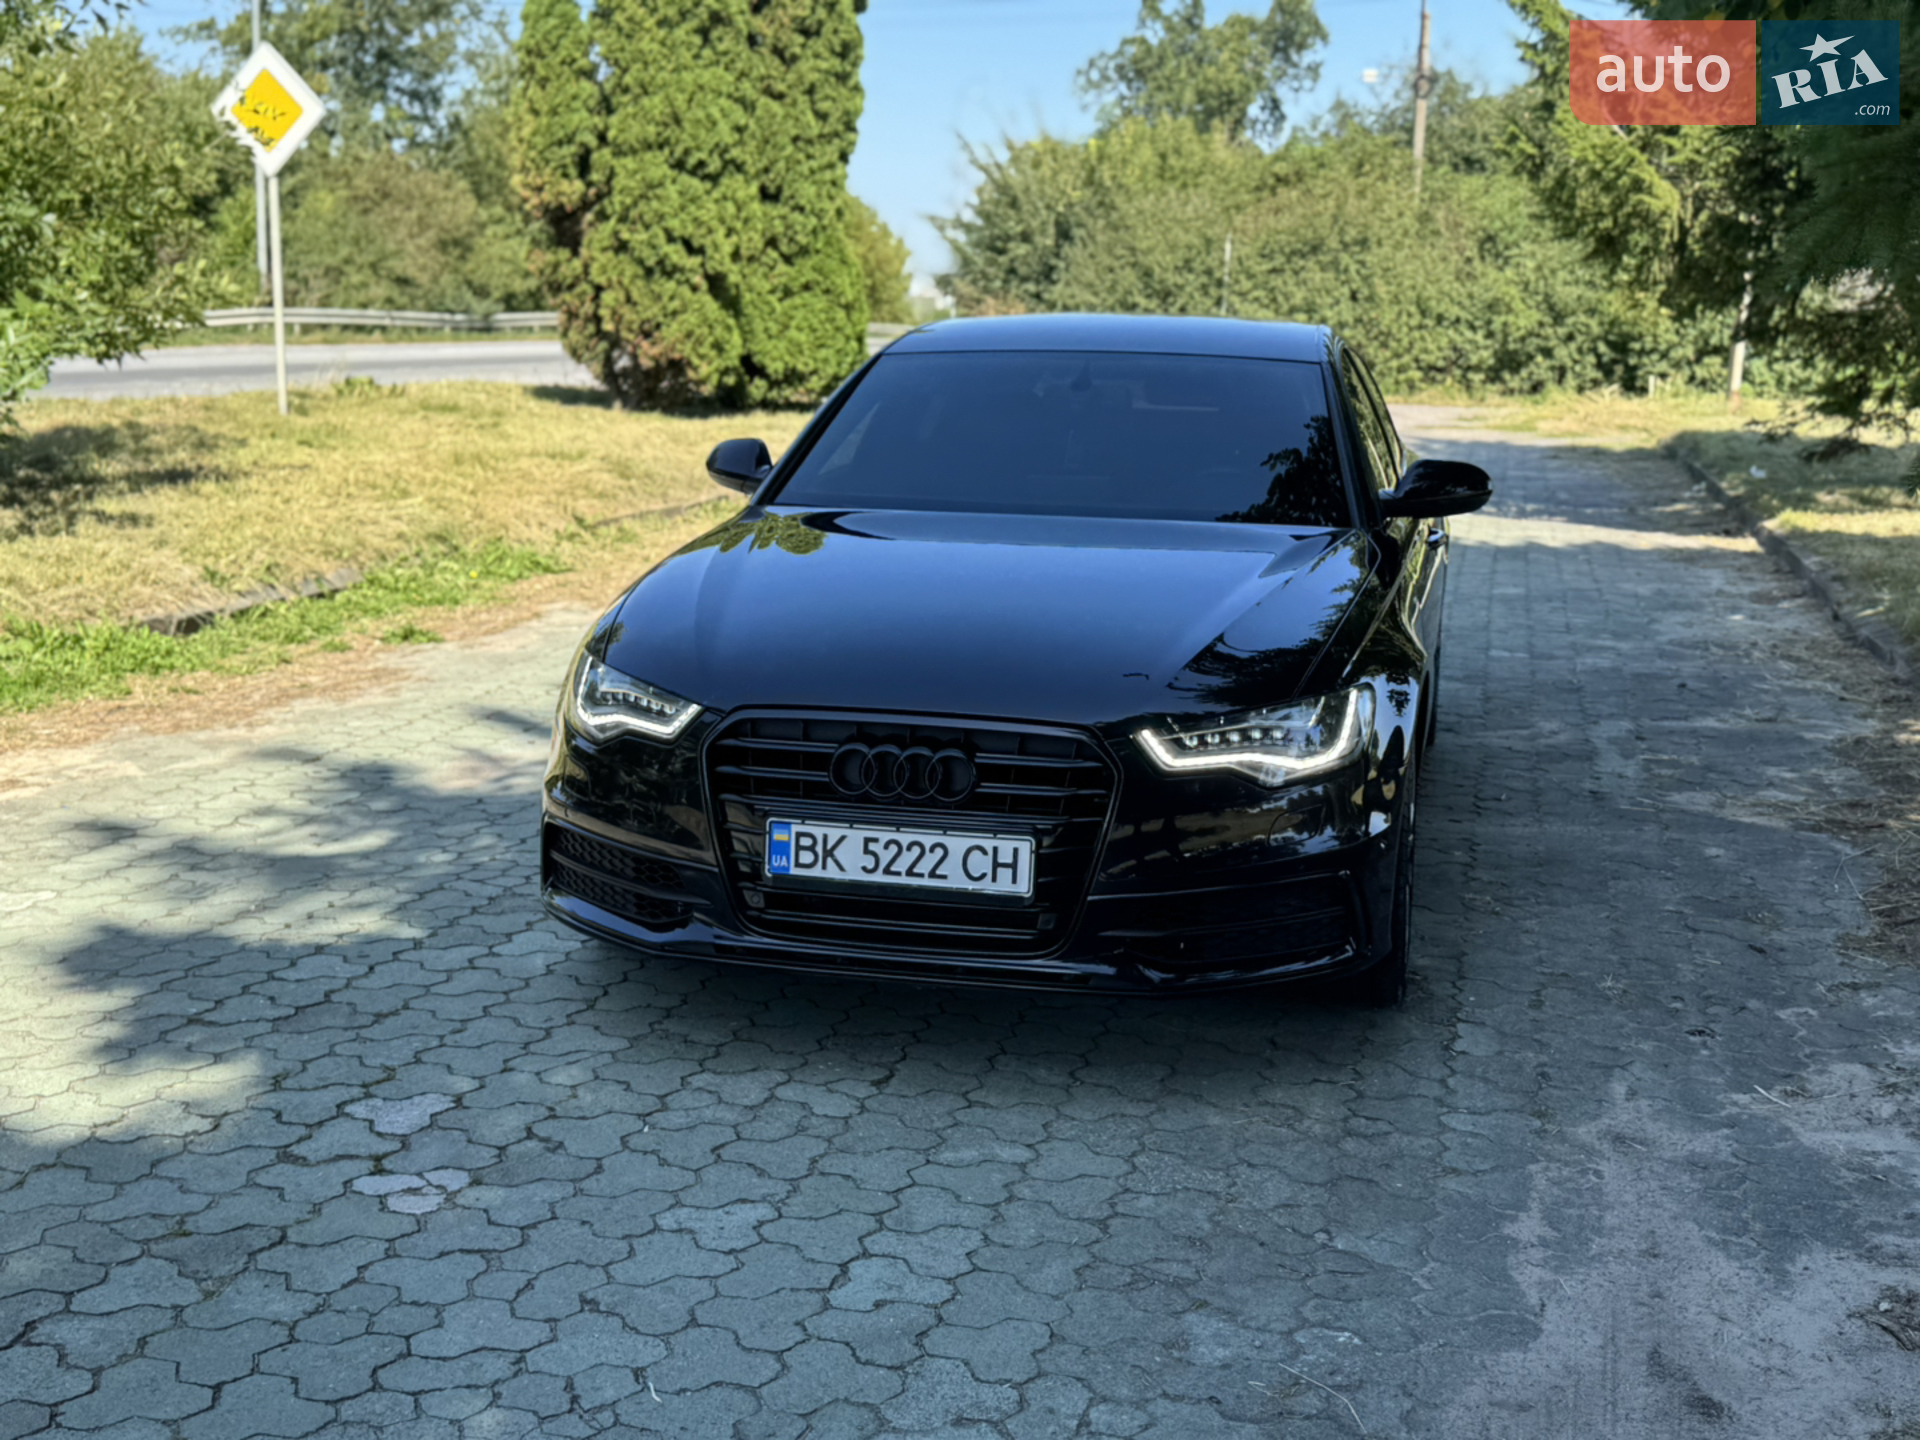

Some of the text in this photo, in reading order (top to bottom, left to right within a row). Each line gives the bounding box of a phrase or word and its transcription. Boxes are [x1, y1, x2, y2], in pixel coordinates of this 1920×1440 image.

[772, 854, 789, 868] UA
[794, 831, 1020, 885] BK 5222 CH
